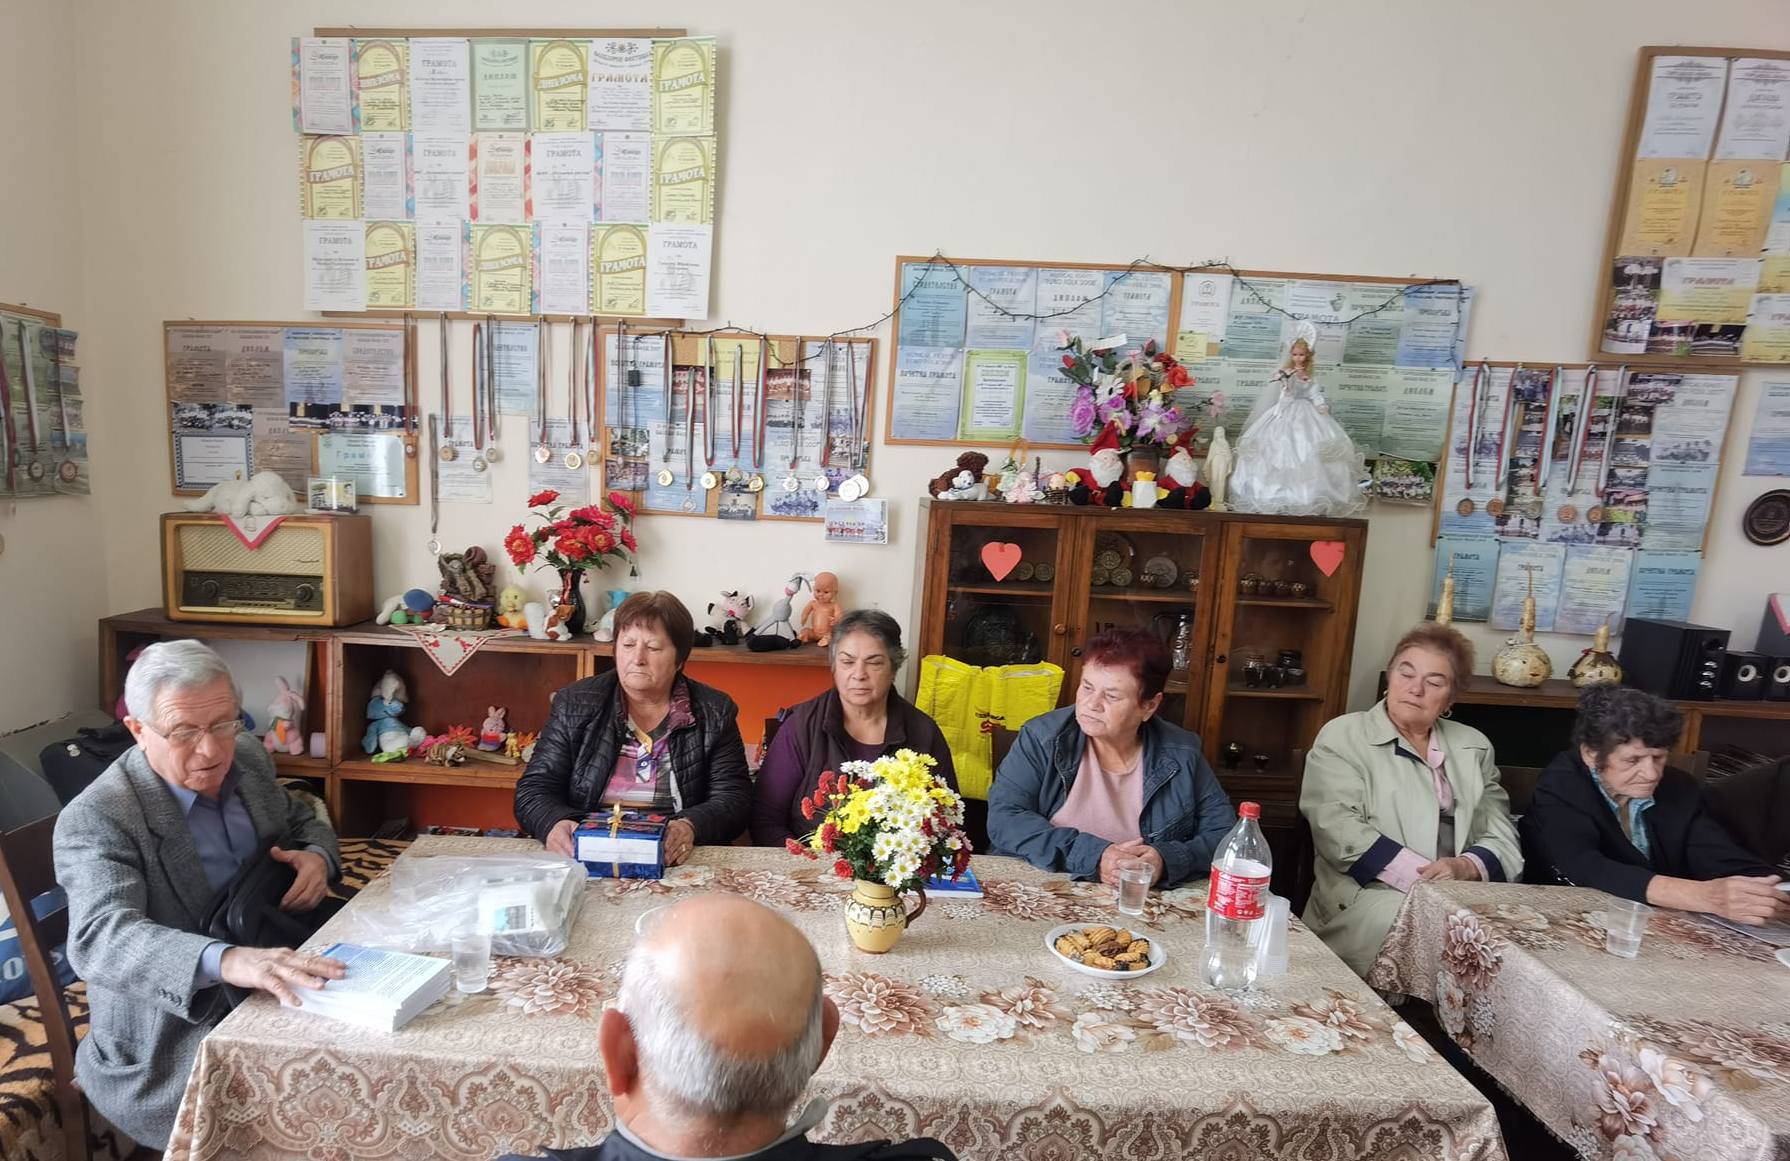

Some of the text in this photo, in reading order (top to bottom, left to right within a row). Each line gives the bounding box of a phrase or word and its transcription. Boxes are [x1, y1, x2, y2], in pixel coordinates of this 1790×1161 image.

[591, 71, 649, 83] ГРАМОТА
[660, 73, 705, 91] ГРАМОТА
[660, 166, 705, 184] ГРАМОТА
[663, 240, 699, 249] ГРАМОТА
[600, 256, 646, 273] ГРАМОТА
